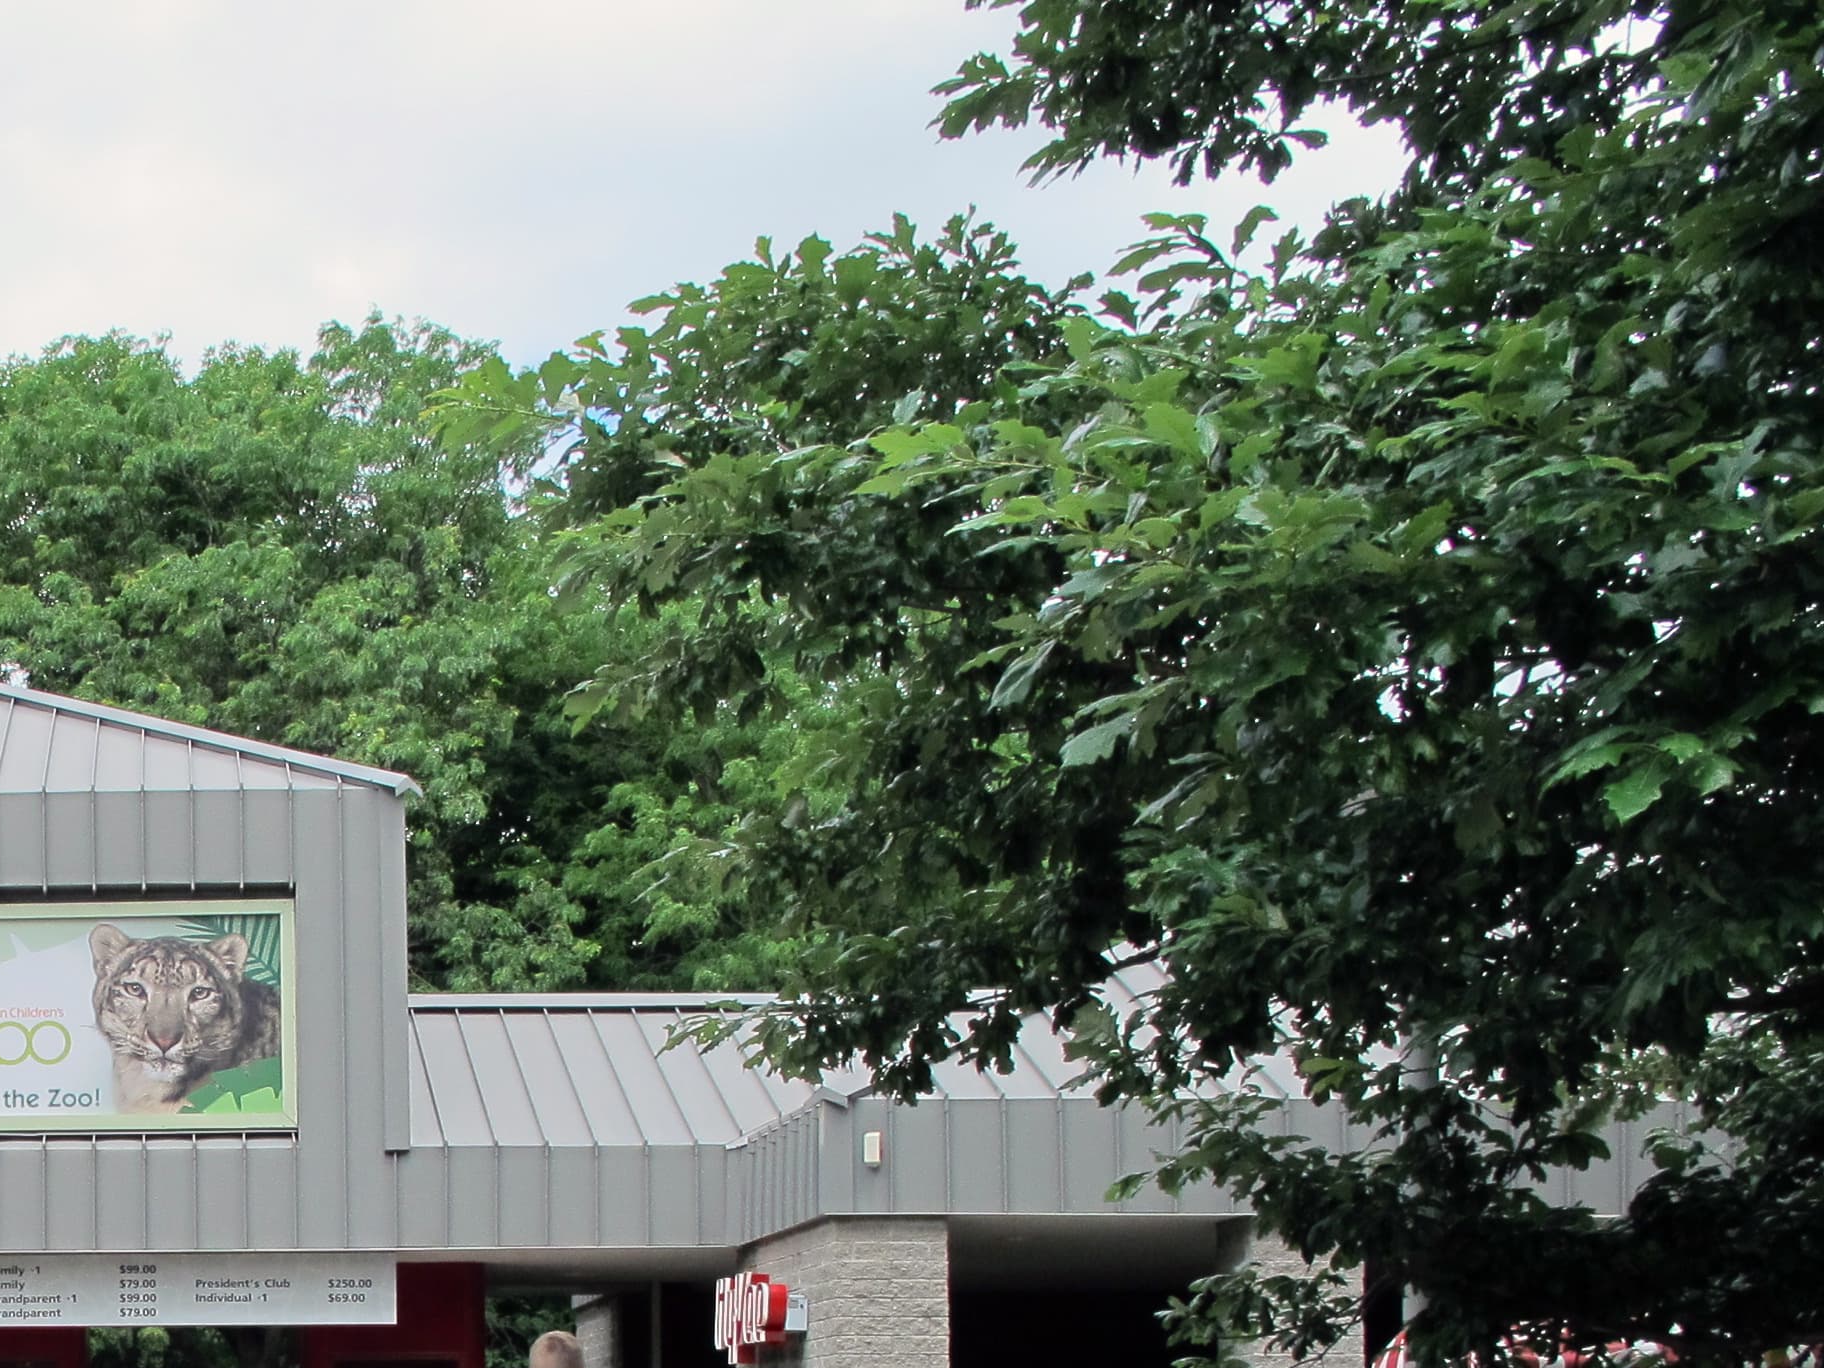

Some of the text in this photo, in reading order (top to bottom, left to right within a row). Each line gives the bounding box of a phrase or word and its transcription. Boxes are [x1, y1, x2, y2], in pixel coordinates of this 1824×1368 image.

[9, 1007, 65, 1019] Children's
[3, 1089, 40, 1109] the
[48, 1088, 101, 1109] Zoo!
[119, 1265, 157, 1274] $99.00
[119, 1279, 157, 1289] $79.00
[195, 1278, 373, 1289] President's Club $250.00
[119, 1294, 157, 1303] $99.00
[195, 1293, 252, 1303] Individual
[328, 1293, 366, 1303] $69.00
[119, 1308, 157, 1318] $79.00
